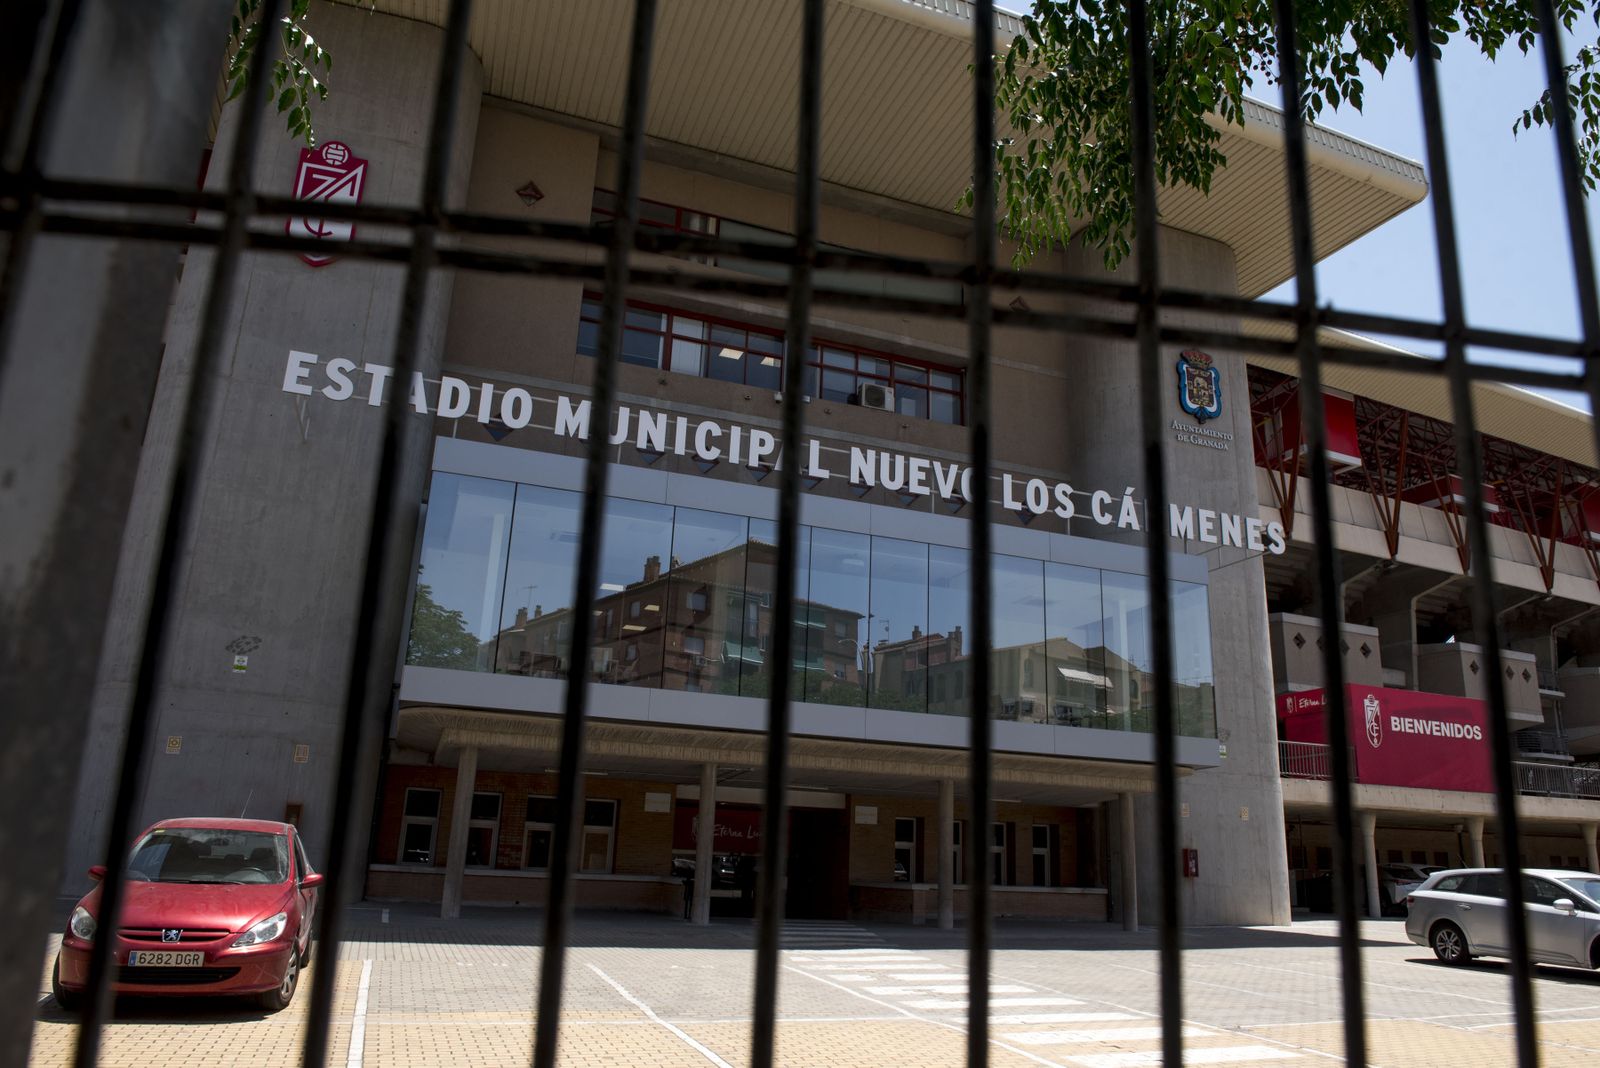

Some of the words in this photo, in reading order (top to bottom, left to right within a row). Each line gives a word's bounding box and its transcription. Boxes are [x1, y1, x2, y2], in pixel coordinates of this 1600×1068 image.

[1172, 420, 1233, 441] AYUNTAMIENTO
[282, 350, 533, 429] ESTADIO
[554, 395, 830, 479] MUNICIPL
[1003, 473, 1075, 519] LOS
[1091, 486, 1286, 555] CÁMENES
[1190, 434, 1229, 451] GRANADA
[1390, 715, 1482, 740] BIENVENIDOS
[139, 952, 172, 966] 6282
[175, 953, 200, 966] DGR
